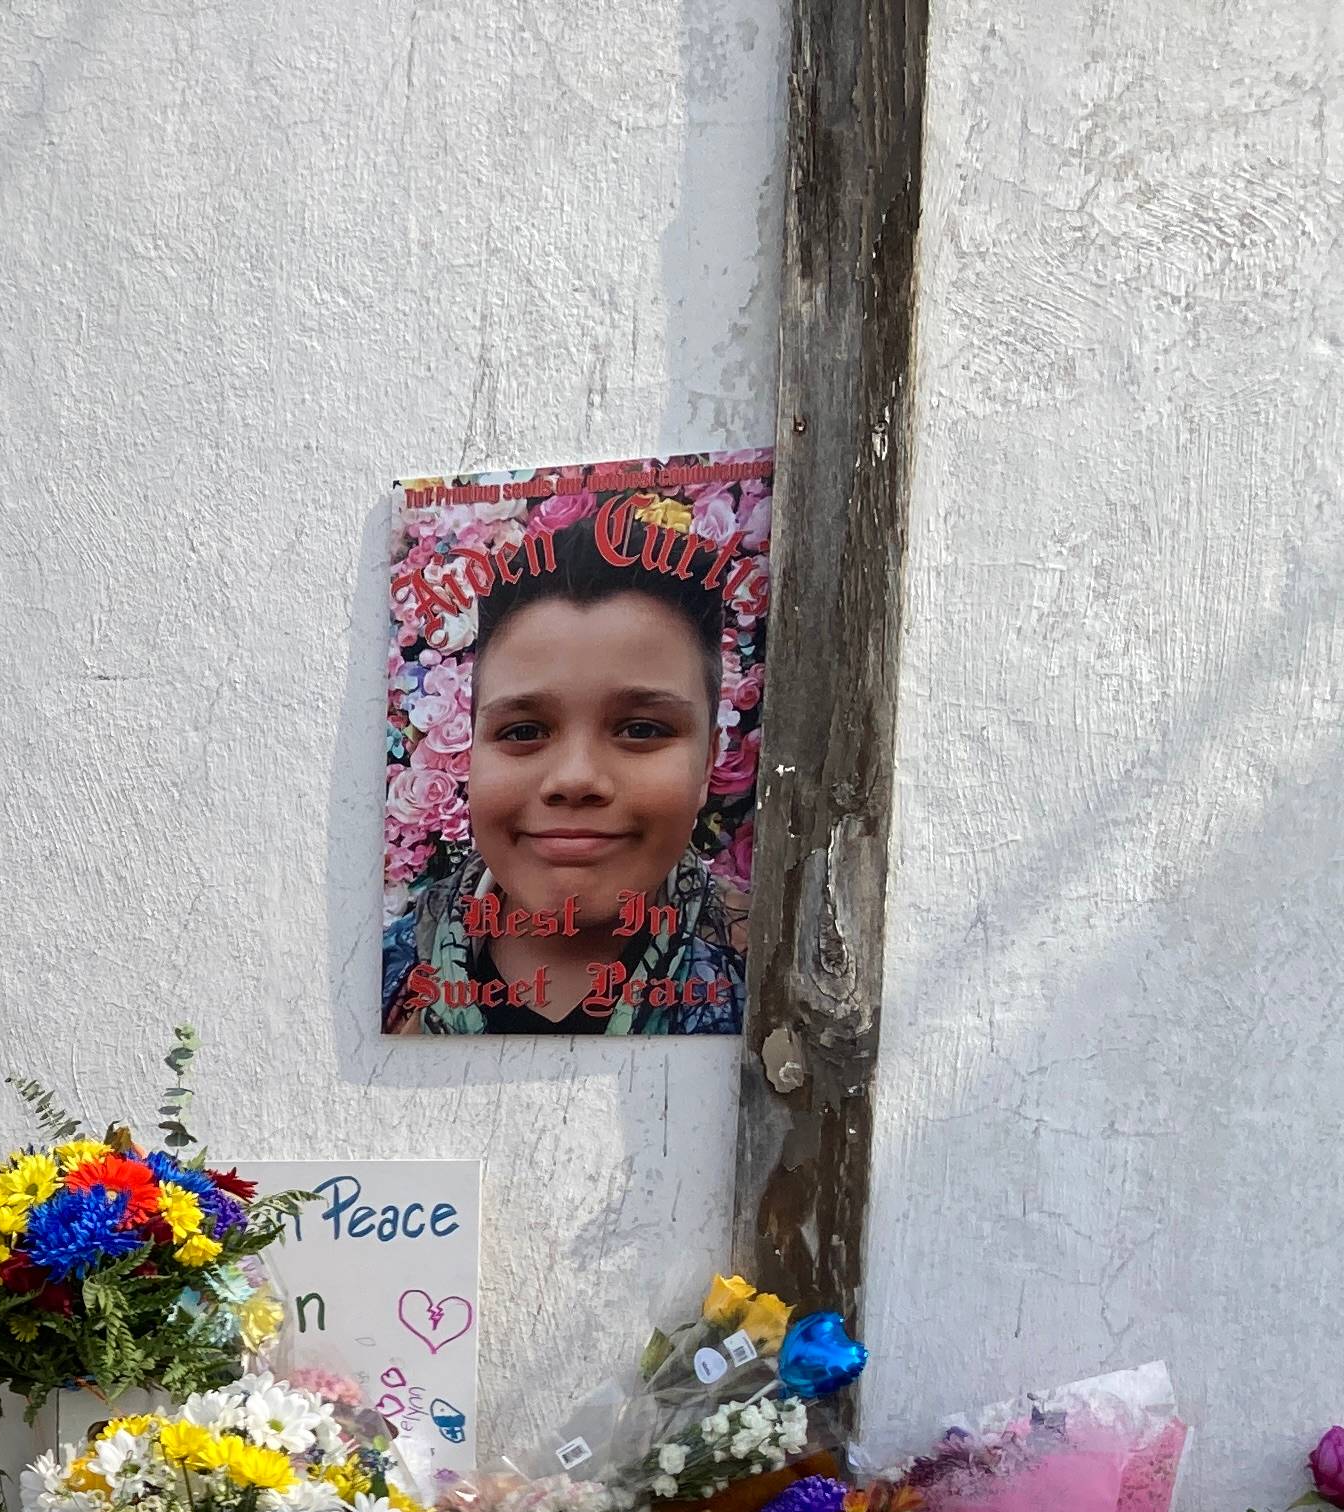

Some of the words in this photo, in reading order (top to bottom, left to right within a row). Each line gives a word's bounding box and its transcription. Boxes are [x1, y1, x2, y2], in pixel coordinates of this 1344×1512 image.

[390, 529, 557, 649] Aiden
[595, 493, 769, 616] Curtis
[462, 892, 582, 938] Rest
[611, 888, 682, 938] In
[403, 964, 553, 1011] Sweet
[577, 960, 736, 1019] Peace
[312, 1174, 460, 1243] Peace
